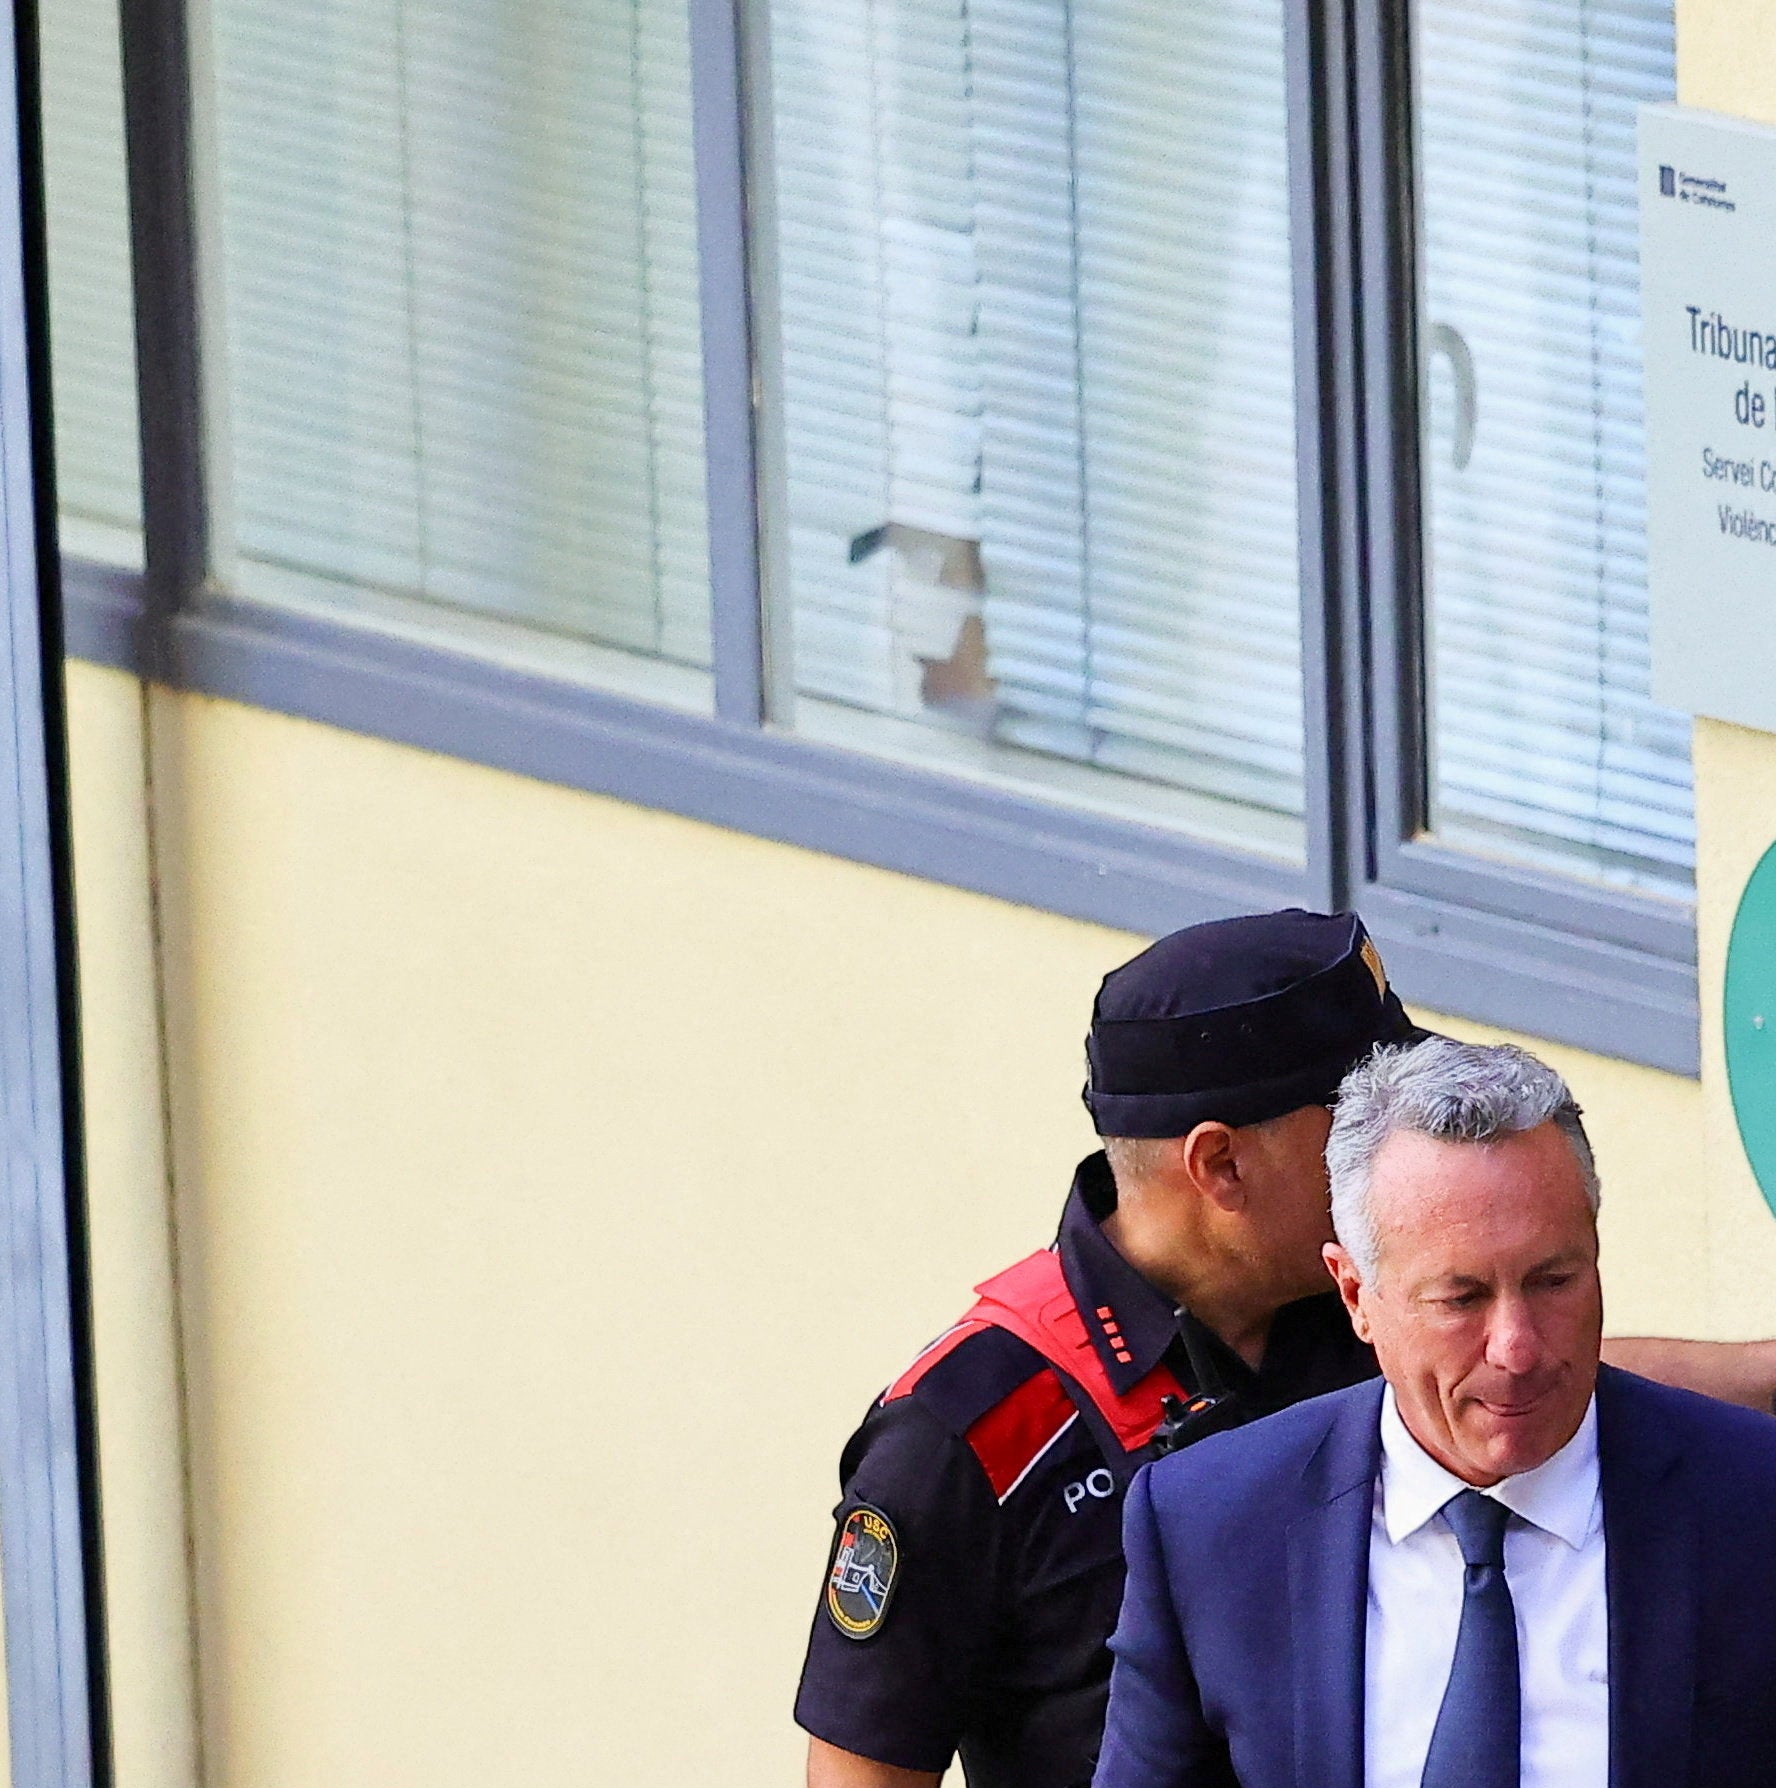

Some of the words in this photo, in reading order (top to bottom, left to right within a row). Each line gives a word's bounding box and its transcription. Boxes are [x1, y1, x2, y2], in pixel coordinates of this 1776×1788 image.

[1735, 380, 1765, 428] de
[1703, 447, 1754, 487] Servei
[1063, 1468, 1115, 1513] PO
